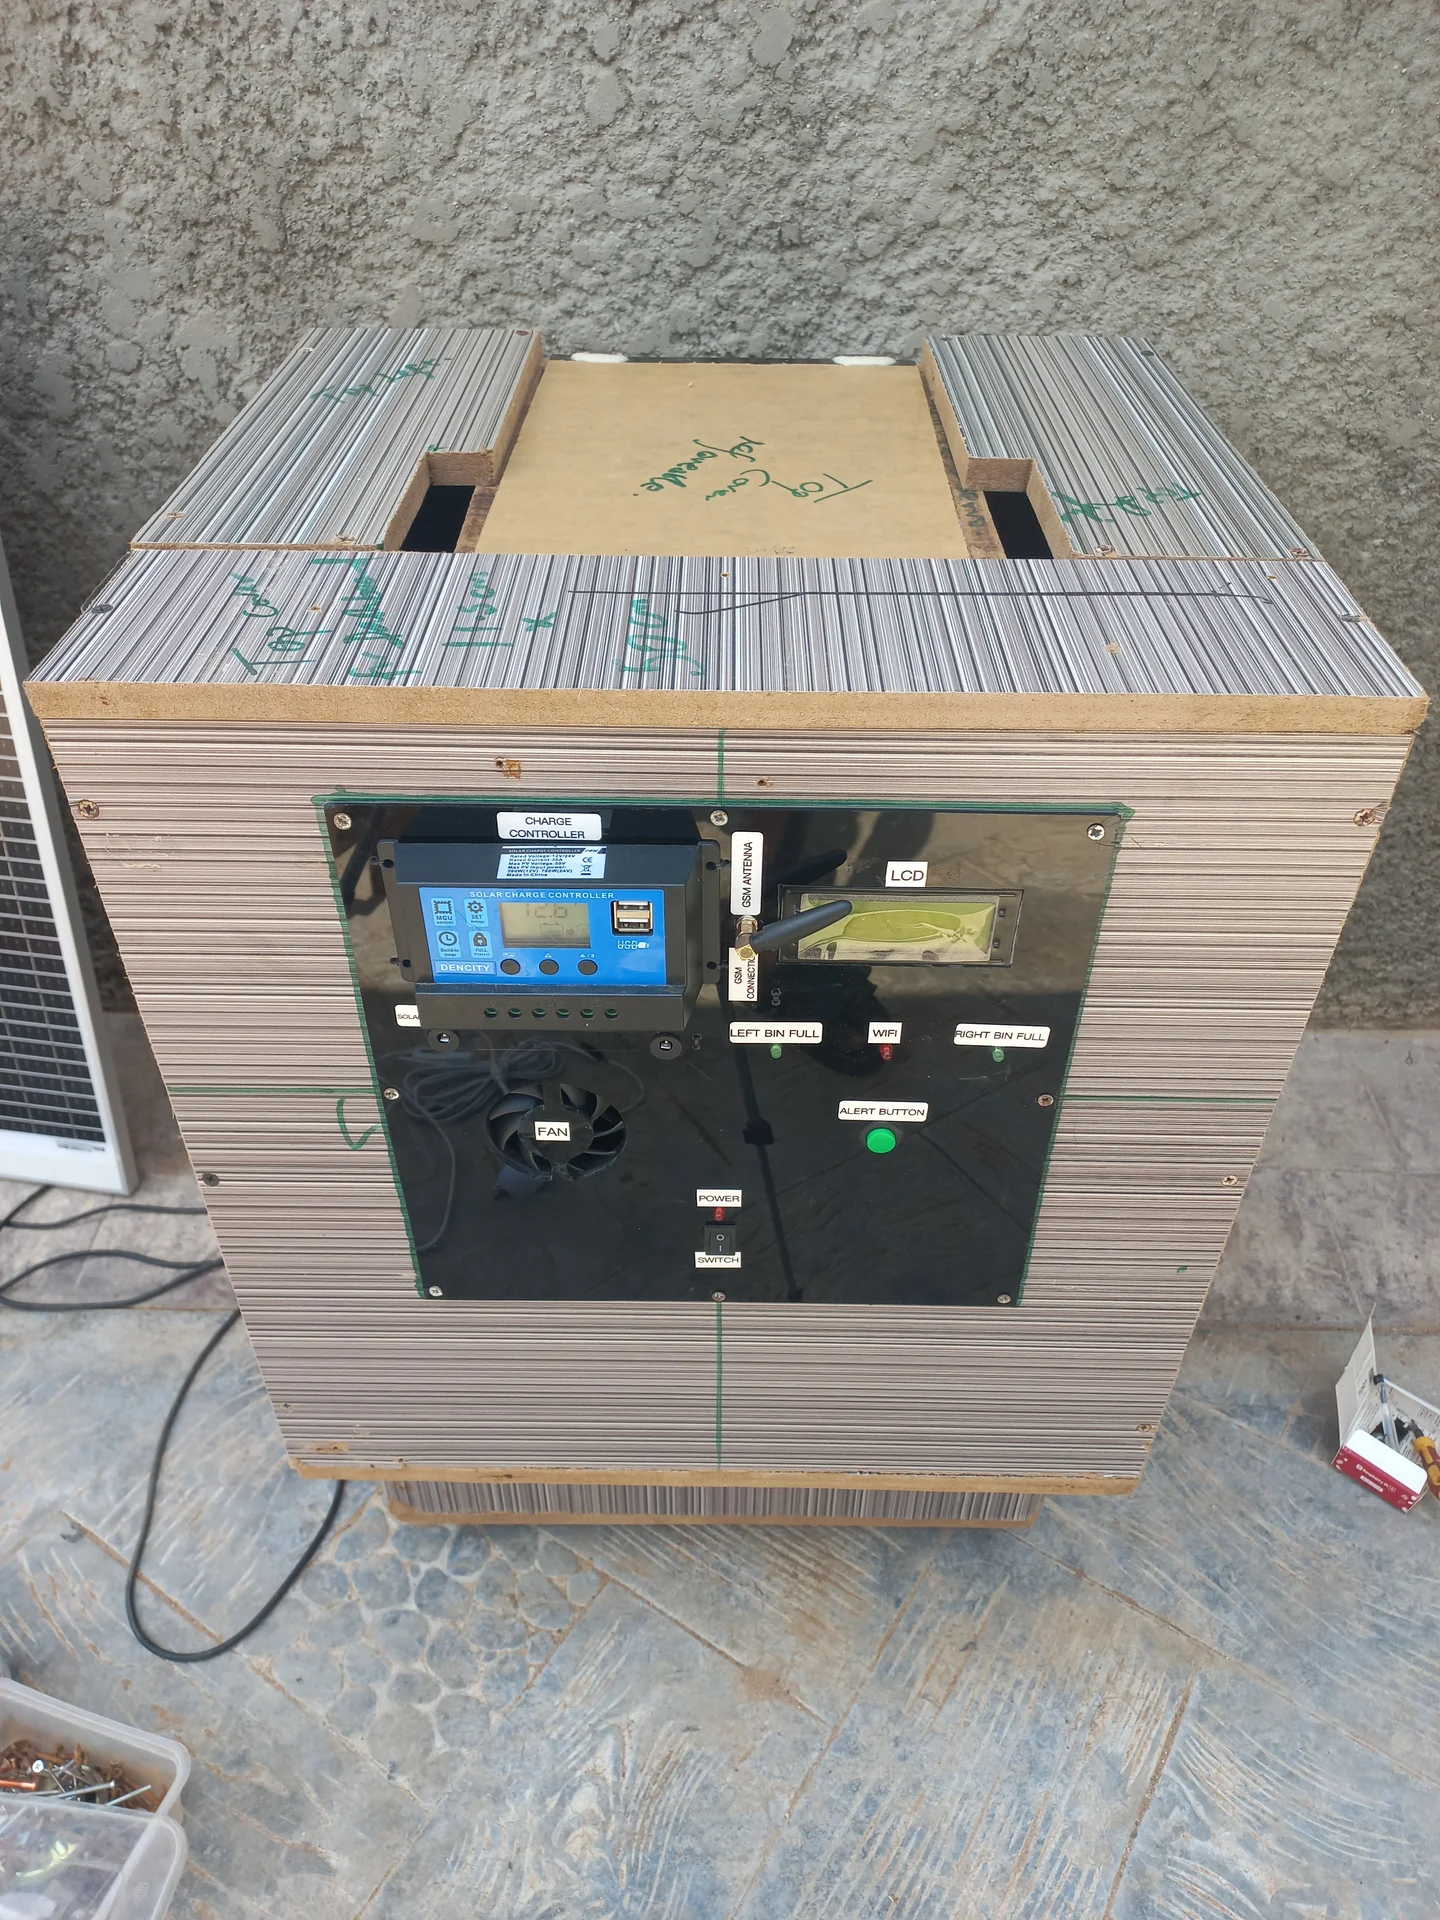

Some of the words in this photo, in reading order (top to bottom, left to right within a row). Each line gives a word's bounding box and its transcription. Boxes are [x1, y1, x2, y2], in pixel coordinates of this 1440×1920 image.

[771, 473, 873, 503] Top
[524, 816, 573, 827] CHARGE
[509, 829, 586, 840] CONTROLLER
[742, 841, 753, 885] ANTENNA
[890, 870, 924, 882] LCD
[741, 886, 751, 908] GSM
[617, 940, 638, 950] USB
[440, 963, 491, 974] DENCITY
[733, 966, 743, 984] GSM
[730, 1028, 760, 1038] LEFT
[764, 1028, 785, 1038] BIN
[789, 1029, 820, 1039] FULL
[872, 1028, 898, 1038] WIFI
[956, 1030, 989, 1040] RIGHT
[993, 1031, 1014, 1040] BIN
[1017, 1032, 1046, 1042] FULL
[839, 1107, 876, 1116] ALERT
[878, 1108, 925, 1117] BUTTON
[537, 1126, 569, 1137] FAN
[697, 1256, 740, 1264] SWITCH
